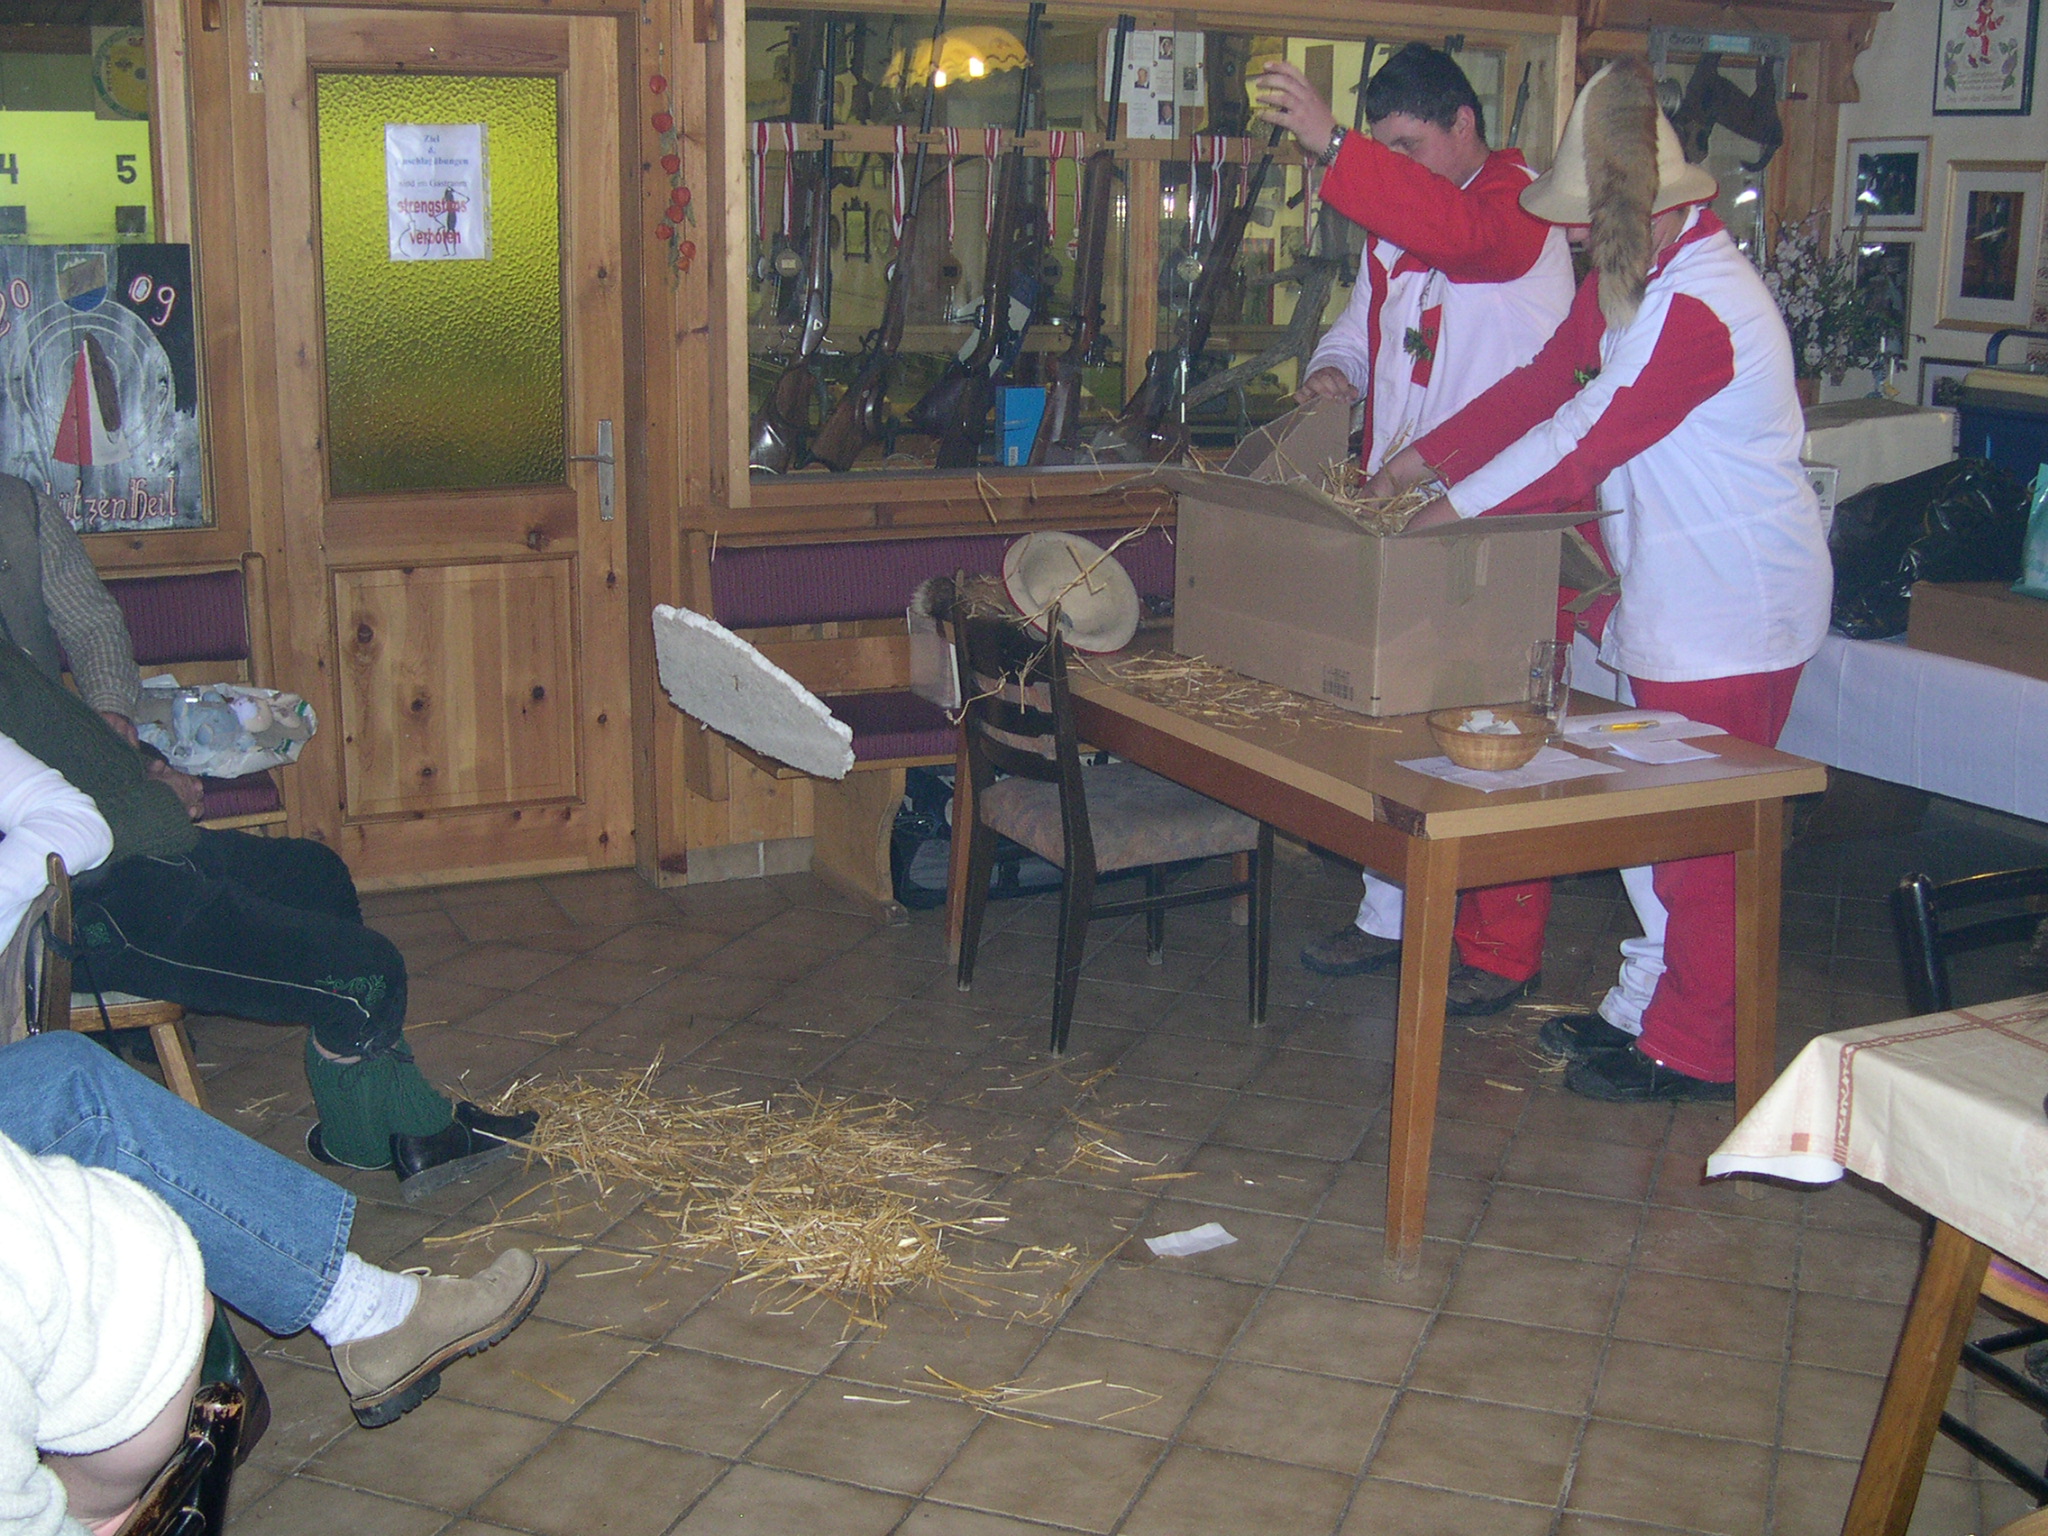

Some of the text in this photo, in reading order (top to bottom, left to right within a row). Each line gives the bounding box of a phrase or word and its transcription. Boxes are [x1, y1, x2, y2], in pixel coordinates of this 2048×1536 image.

[0, 153, 18, 184] 4
[115, 154, 137, 184] 5
[410, 228, 461, 245] verboten
[129, 274, 176, 327] 09
